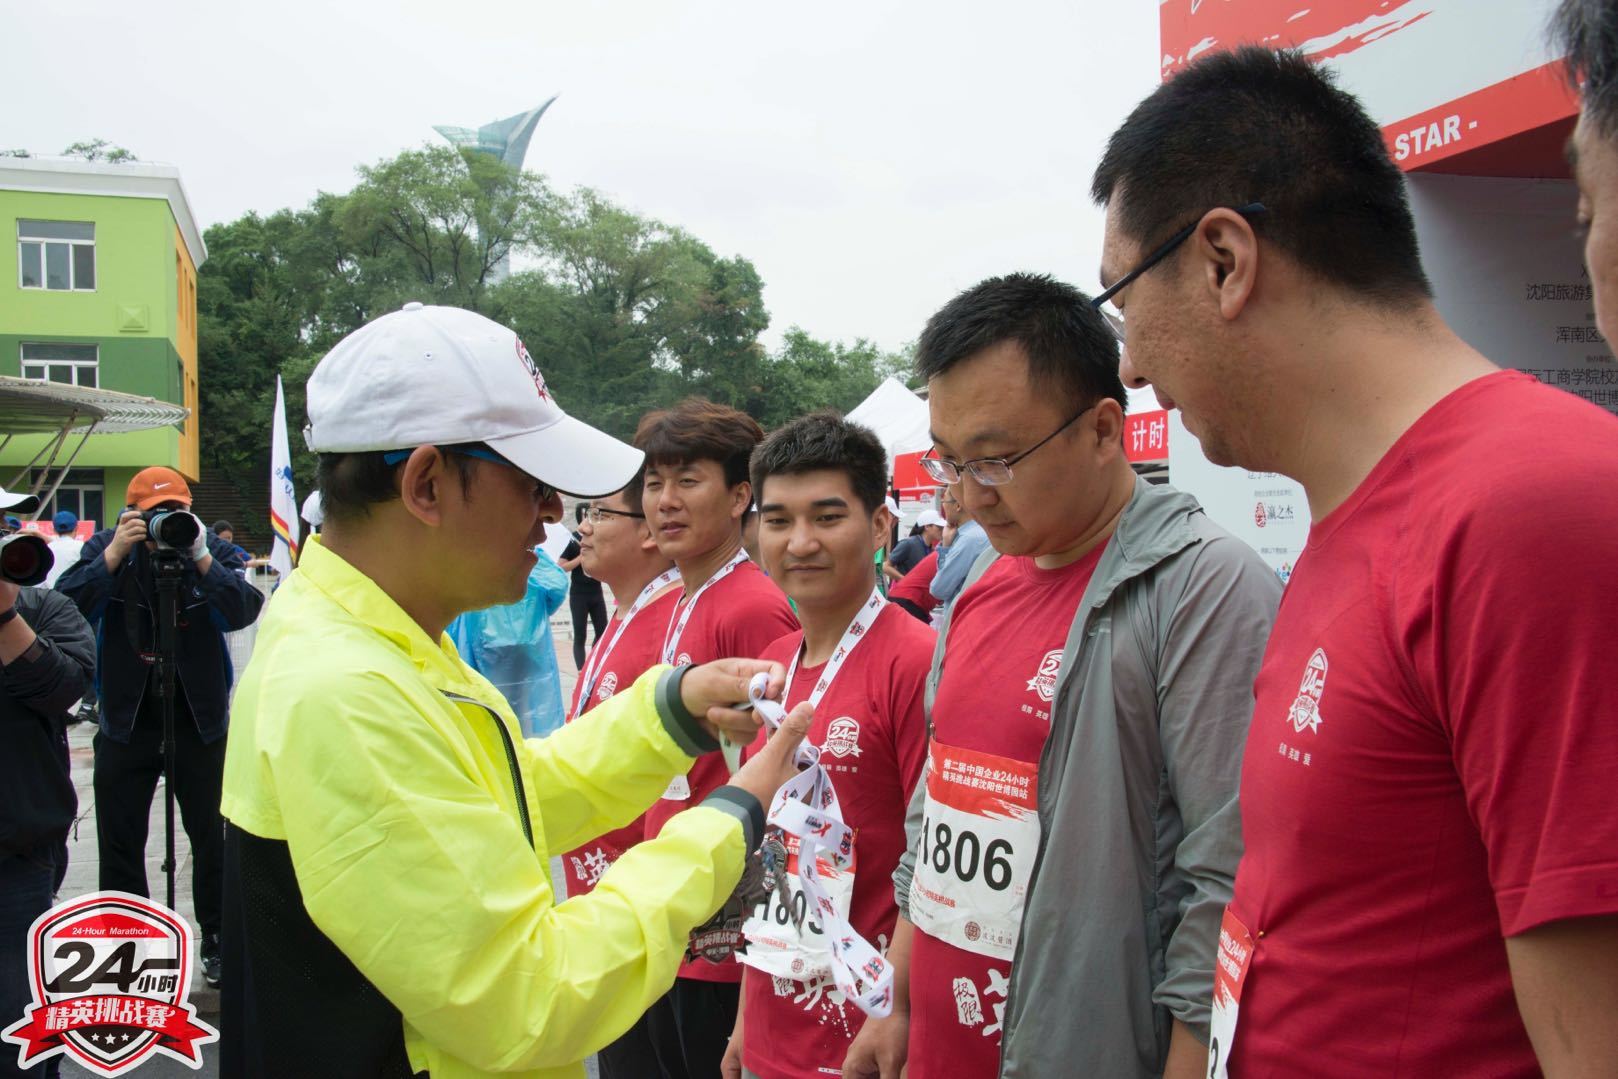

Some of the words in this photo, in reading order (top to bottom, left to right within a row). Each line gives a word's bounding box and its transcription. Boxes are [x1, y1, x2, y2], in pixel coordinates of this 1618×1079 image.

[1394, 114, 1461, 161] STAR
[1556, 326, 1605, 343] 浑南区
[828, 726, 849, 740] 24
[923, 816, 1014, 891] 1806
